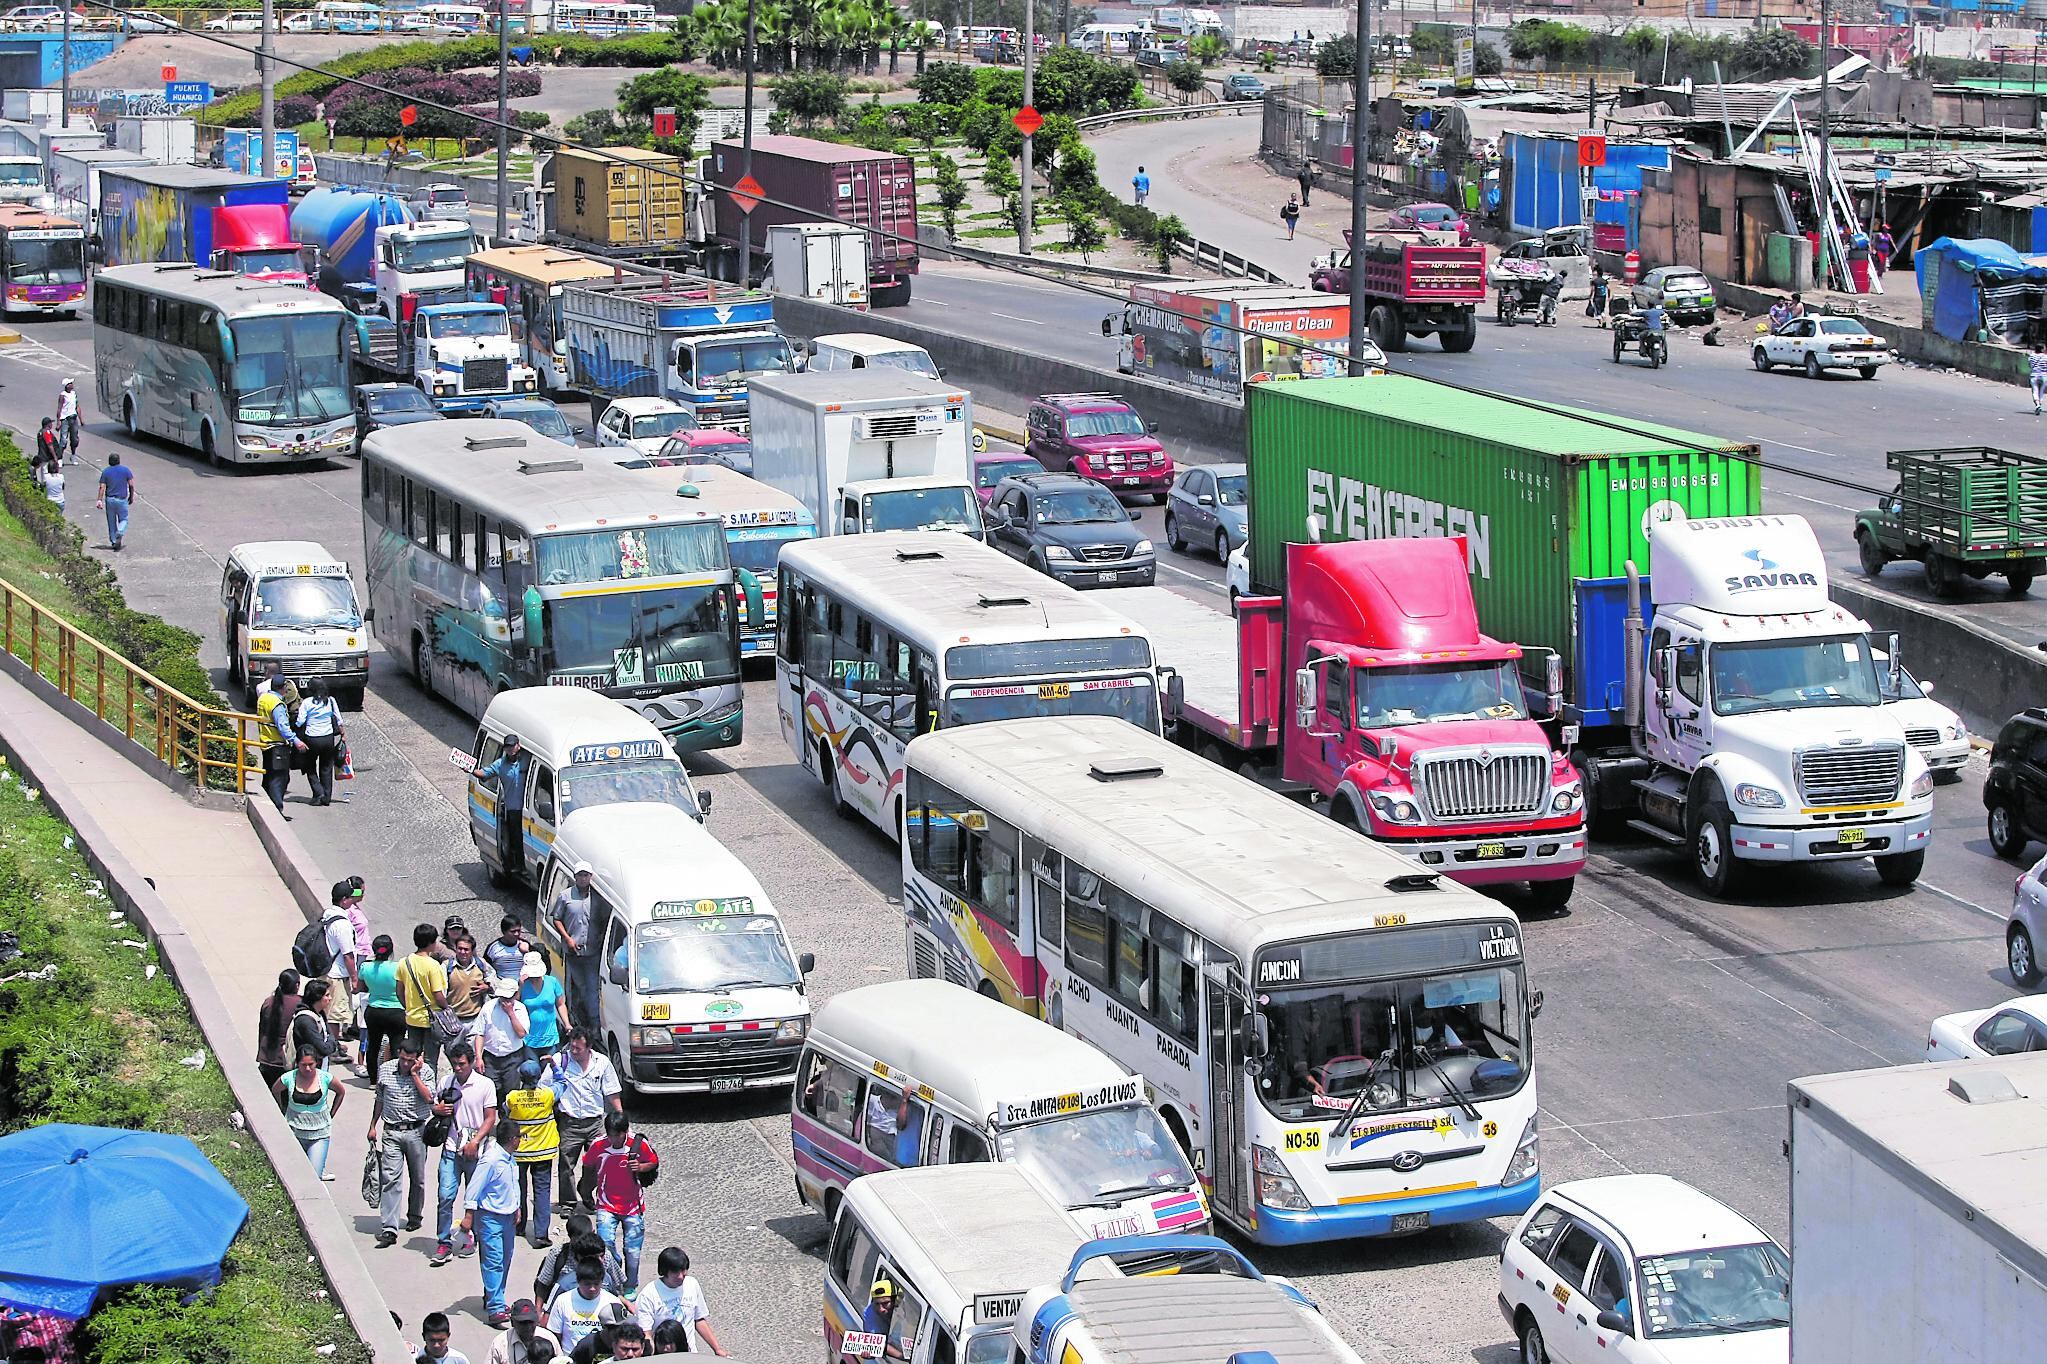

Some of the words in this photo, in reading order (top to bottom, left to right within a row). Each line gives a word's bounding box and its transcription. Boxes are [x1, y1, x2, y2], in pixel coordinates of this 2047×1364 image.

[173, 84, 201, 92] PUENTE
[1248, 317, 1292, 333] Chema
[1296, 316, 1333, 331] Clean
[1612, 479, 1647, 492] EMCU
[730, 513, 760, 525] S.M.P.
[775, 512, 797, 523] VICTORIA
[1308, 468, 1490, 579] EVERGREEN
[738, 530, 778, 541] Rubencito
[265, 566, 295, 575] VENTANILLA
[313, 566, 320, 574] EL
[320, 565, 343, 574] AGUSTINO
[1725, 573, 1818, 592] SAVAR
[658, 663, 704, 682] HUARAL
[552, 676, 606, 690] HUARAL
[970, 687, 1025, 697] INDEPENDENCIA
[1038, 685, 1069, 699] NM-46
[1083, 681, 1100, 690] SAN
[1102, 679, 1134, 689] GABRIEL
[928, 710, 938, 733] 7
[575, 746, 604, 763] ATE
[623, 742, 661, 759] CALLAO
[655, 903, 692, 917] CALLAO
[722, 900, 752, 914] ATE
[939, 891, 964, 920] ANCON
[1374, 914, 1406, 926] NO-50
[1489, 926, 1503, 939] LA
[1260, 959, 1300, 982] ANCON
[1479, 936, 1519, 960] VICTORIA
[1067, 975, 1090, 1003] ACHO
[1106, 1000, 1140, 1037] HUANTA
[1156, 1033, 1191, 1071] PARADA
[1030, 1096, 1057, 1117] ANITA
[1100, 1082, 1137, 1104] OLIVOS
[1397, 1118, 1438, 1133] ESTRELLA
[1483, 1122, 1497, 1136] 38
[1286, 1132, 1320, 1149] NO-50
[859, 1334, 883, 1345] PERU
